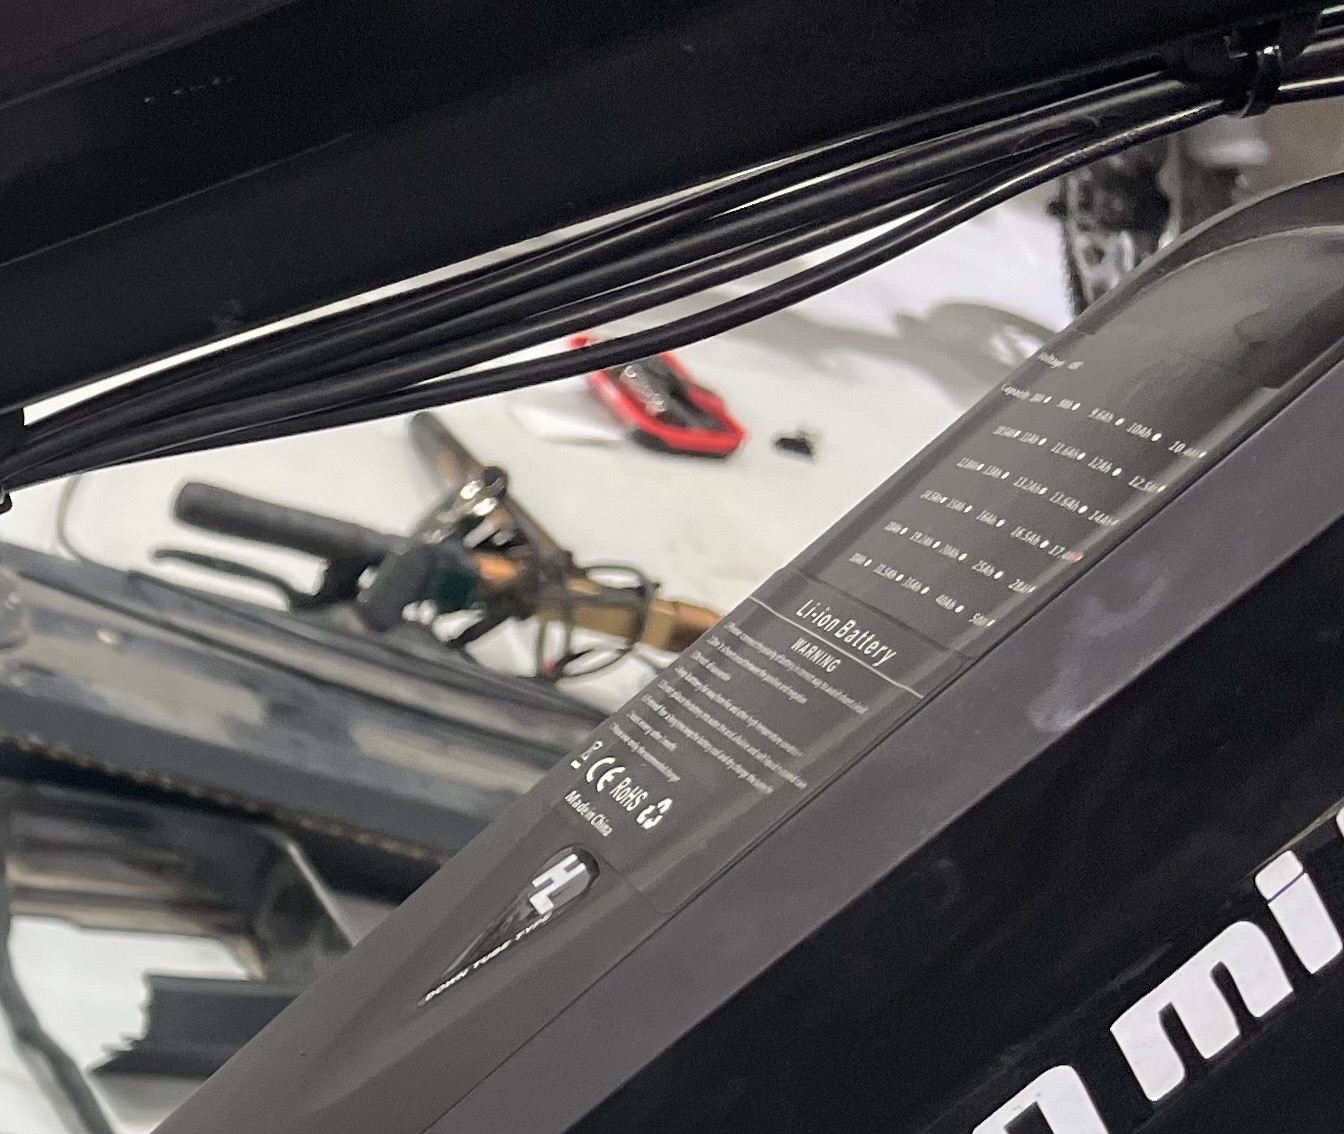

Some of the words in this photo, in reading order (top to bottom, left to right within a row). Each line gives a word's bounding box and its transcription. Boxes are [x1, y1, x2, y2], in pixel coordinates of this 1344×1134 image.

[1126, 422, 1152, 439] 10Ah
[1088, 456, 1113, 473] 12Ah
[972, 560, 995, 577] 25Ah
[796, 599, 840, 632] Li-ion
[834, 619, 897, 667] Battery
[790, 637, 842, 673] WARNING
[609, 777, 648, 812] RoHS
[564, 790, 590, 816] Made
[591, 813, 613, 837] China
[1110, 804, 1344, 1102] mi
